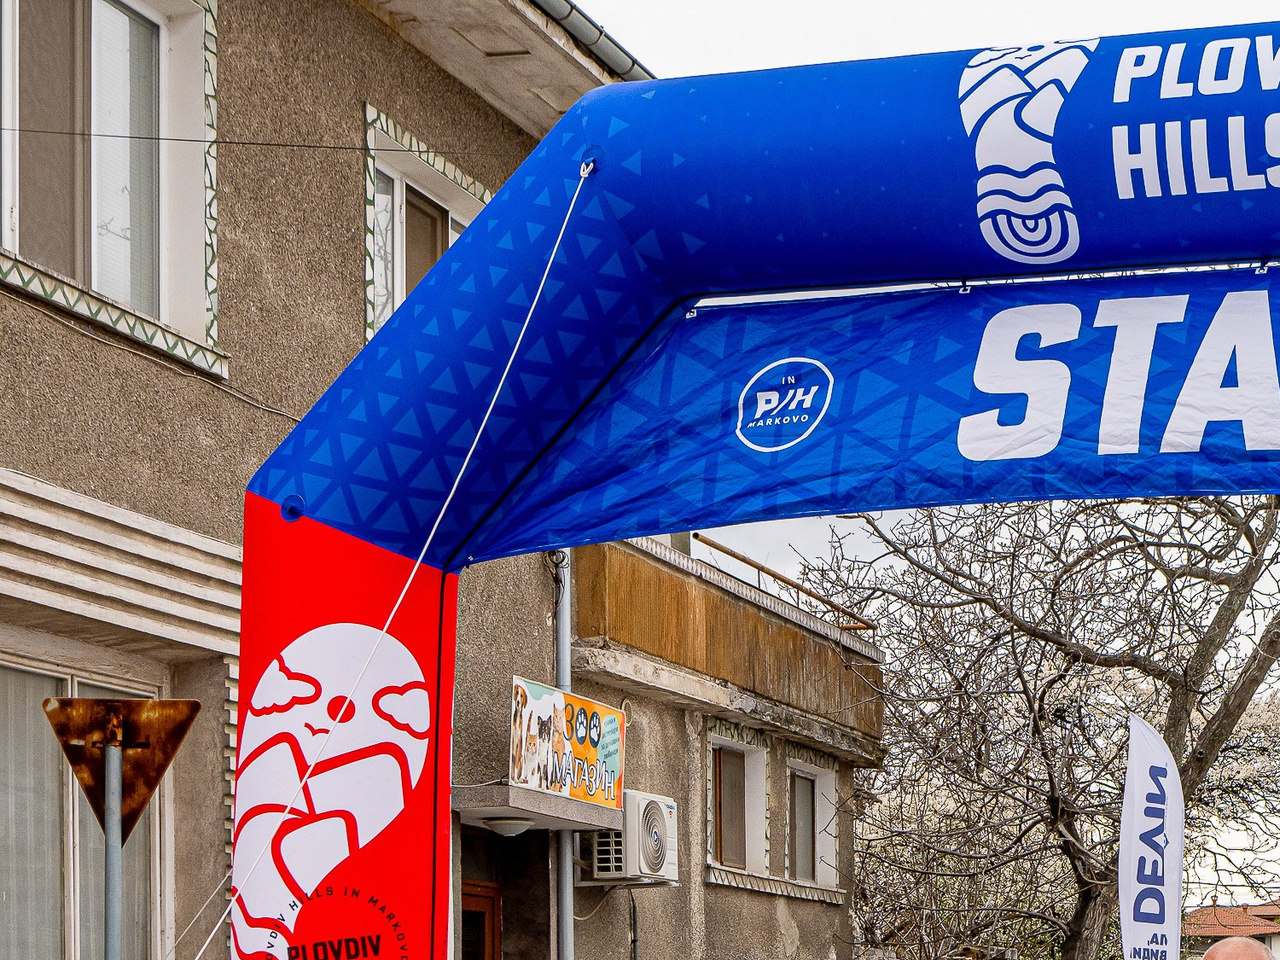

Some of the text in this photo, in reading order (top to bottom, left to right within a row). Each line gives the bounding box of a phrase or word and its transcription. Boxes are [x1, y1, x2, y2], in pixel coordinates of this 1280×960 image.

[781, 375, 796, 385] IN
[754, 385, 820, 420] P/H
[747, 414, 809, 429] MARKOVO
[552, 750, 616, 800] МАГАЗИН
[344, 887, 361, 899] IN
